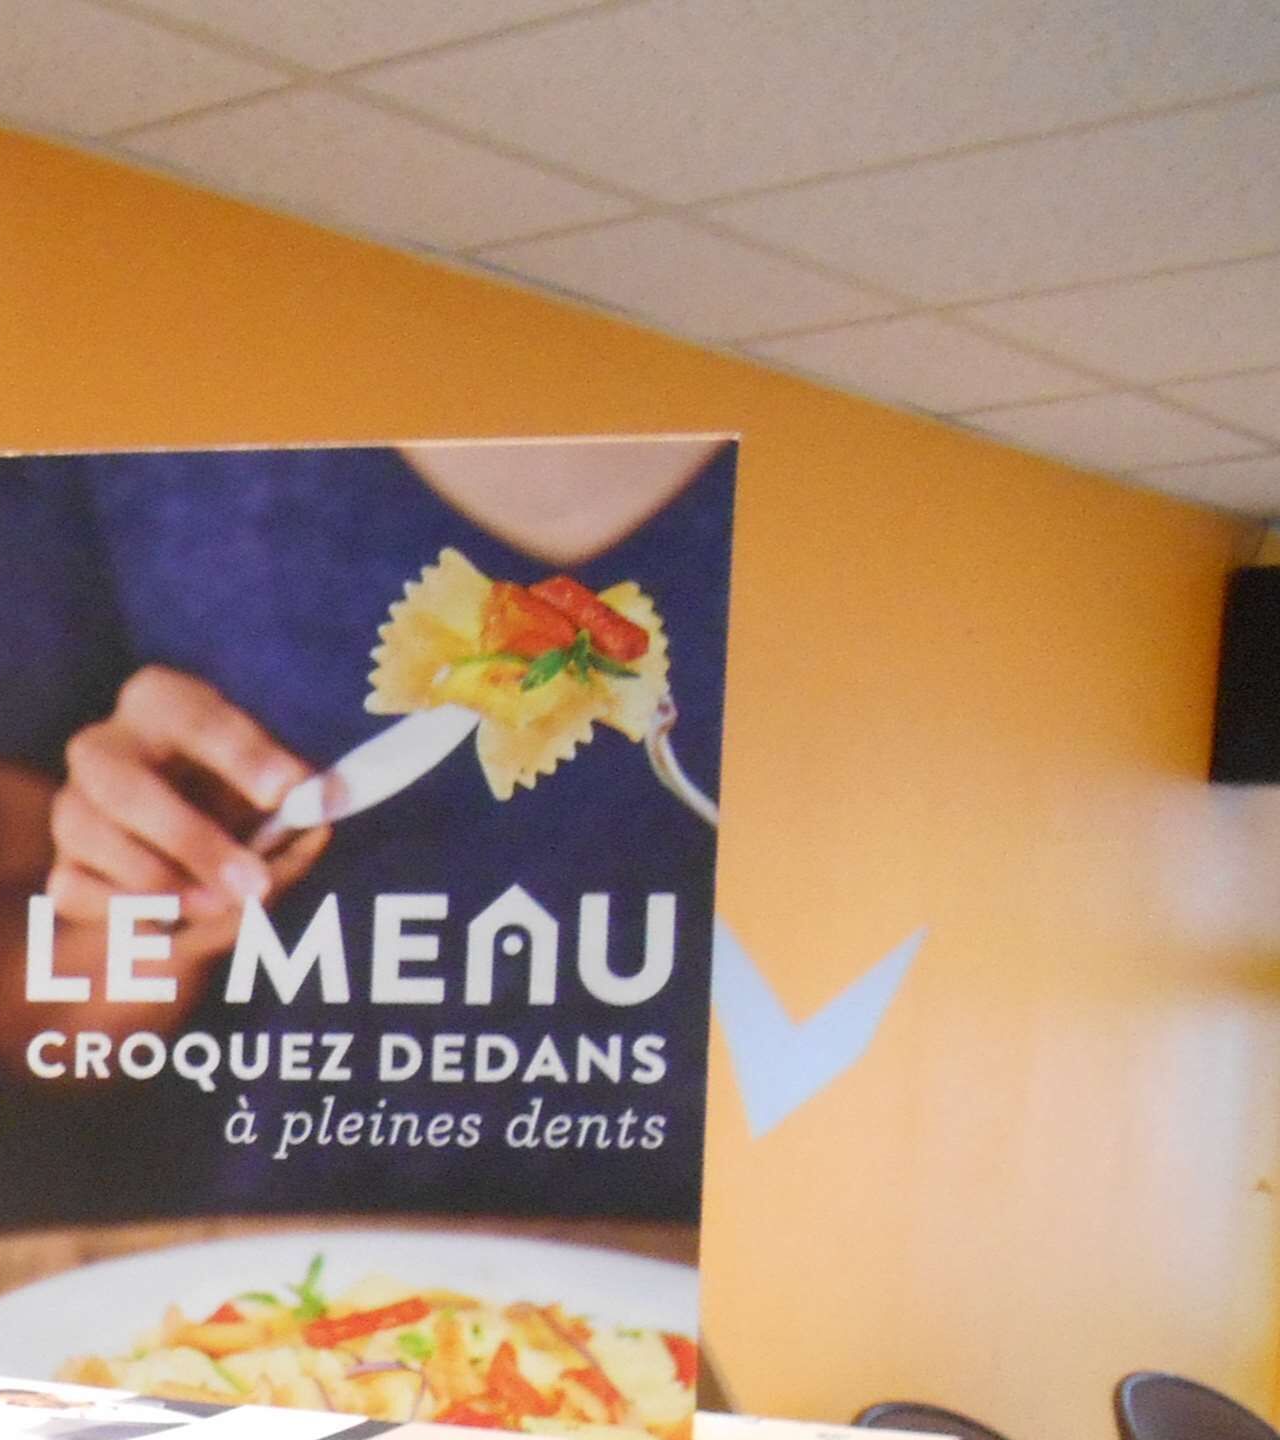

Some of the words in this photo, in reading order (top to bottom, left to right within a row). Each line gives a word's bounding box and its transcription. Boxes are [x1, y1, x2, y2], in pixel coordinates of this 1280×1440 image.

[25, 893, 180, 1003] LE
[25, 1031, 352, 1091] CROQUEZ
[379, 1034, 668, 1085] DEDANS
[225, 1097, 258, 1146] à
[274, 1100, 482, 1160] pleines
[505, 1098, 668, 1151] dents
